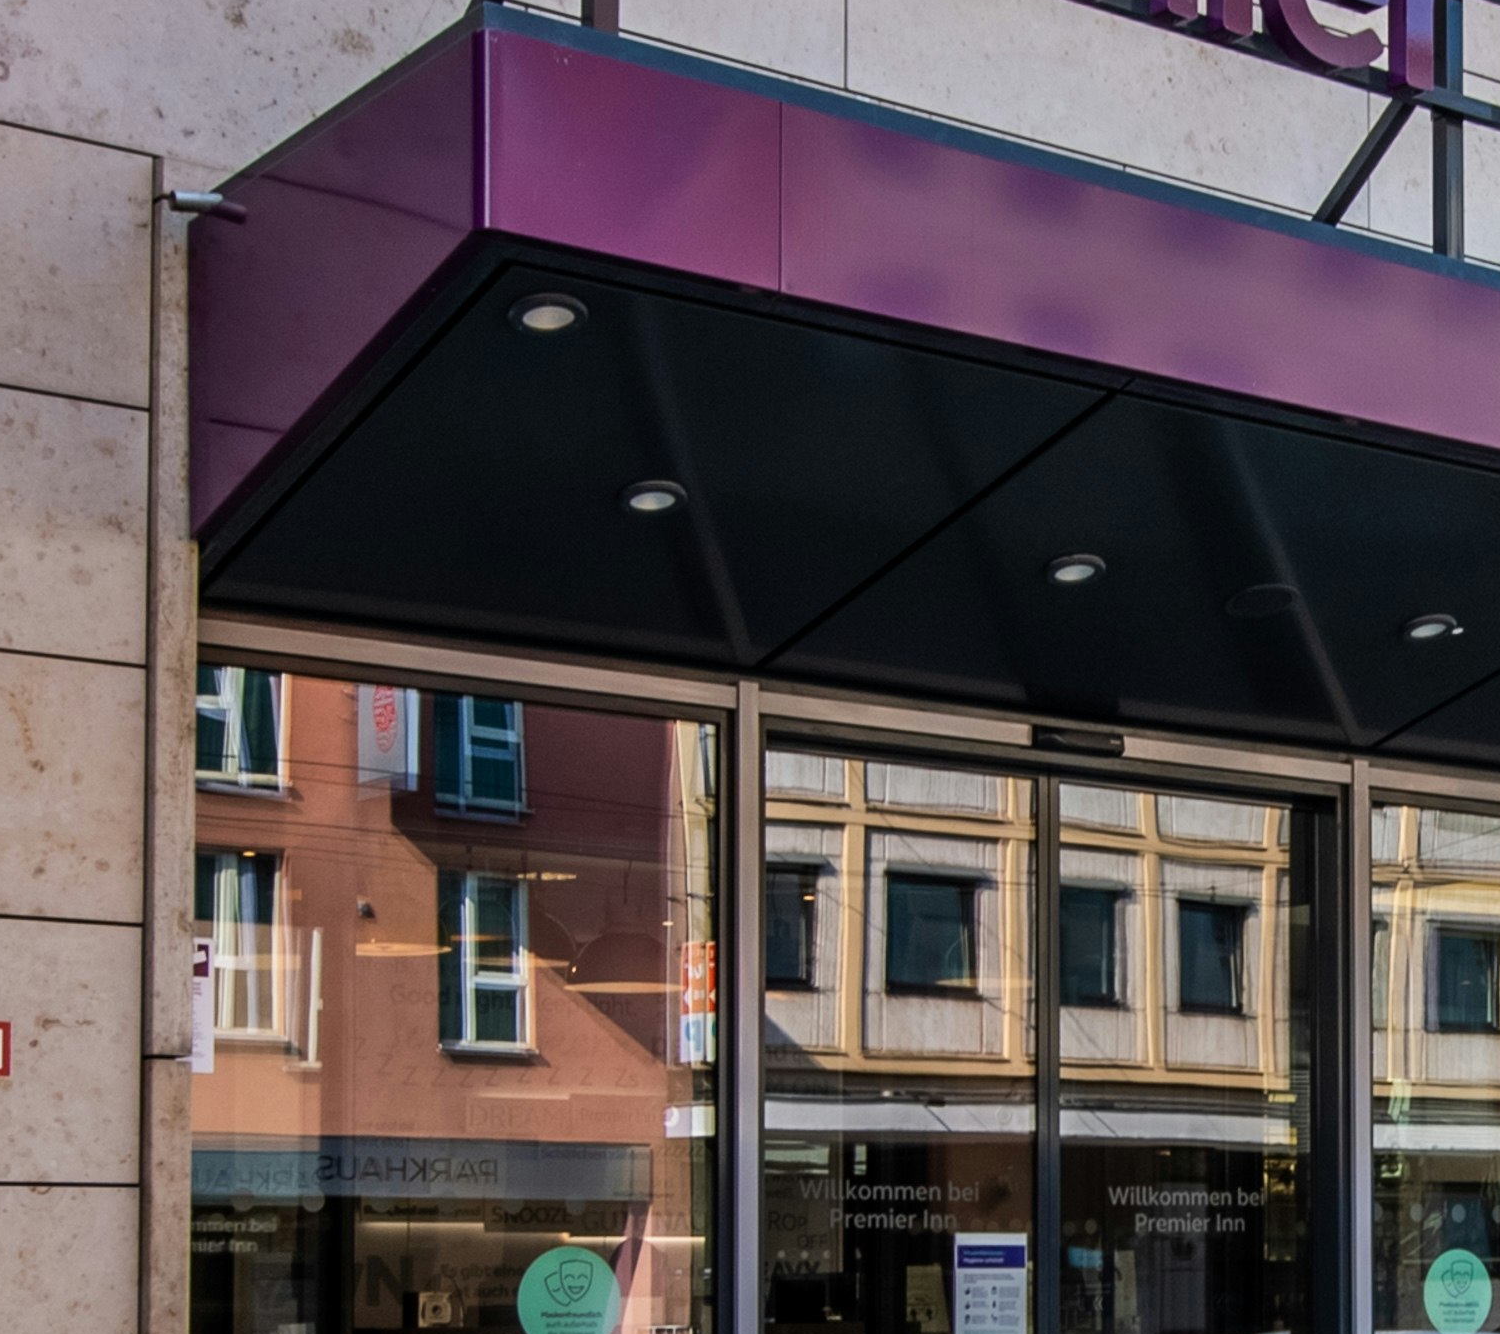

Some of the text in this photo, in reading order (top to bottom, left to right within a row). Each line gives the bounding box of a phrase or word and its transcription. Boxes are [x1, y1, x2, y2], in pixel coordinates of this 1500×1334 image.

[800, 1179, 942, 1201] Willkommen
[948, 1181, 980, 1202] bei
[1108, 1185, 1266, 1206] Willkommen bei
[830, 1208, 957, 1229] Premier Inn
[1135, 1212, 1246, 1233] Premier Inn
